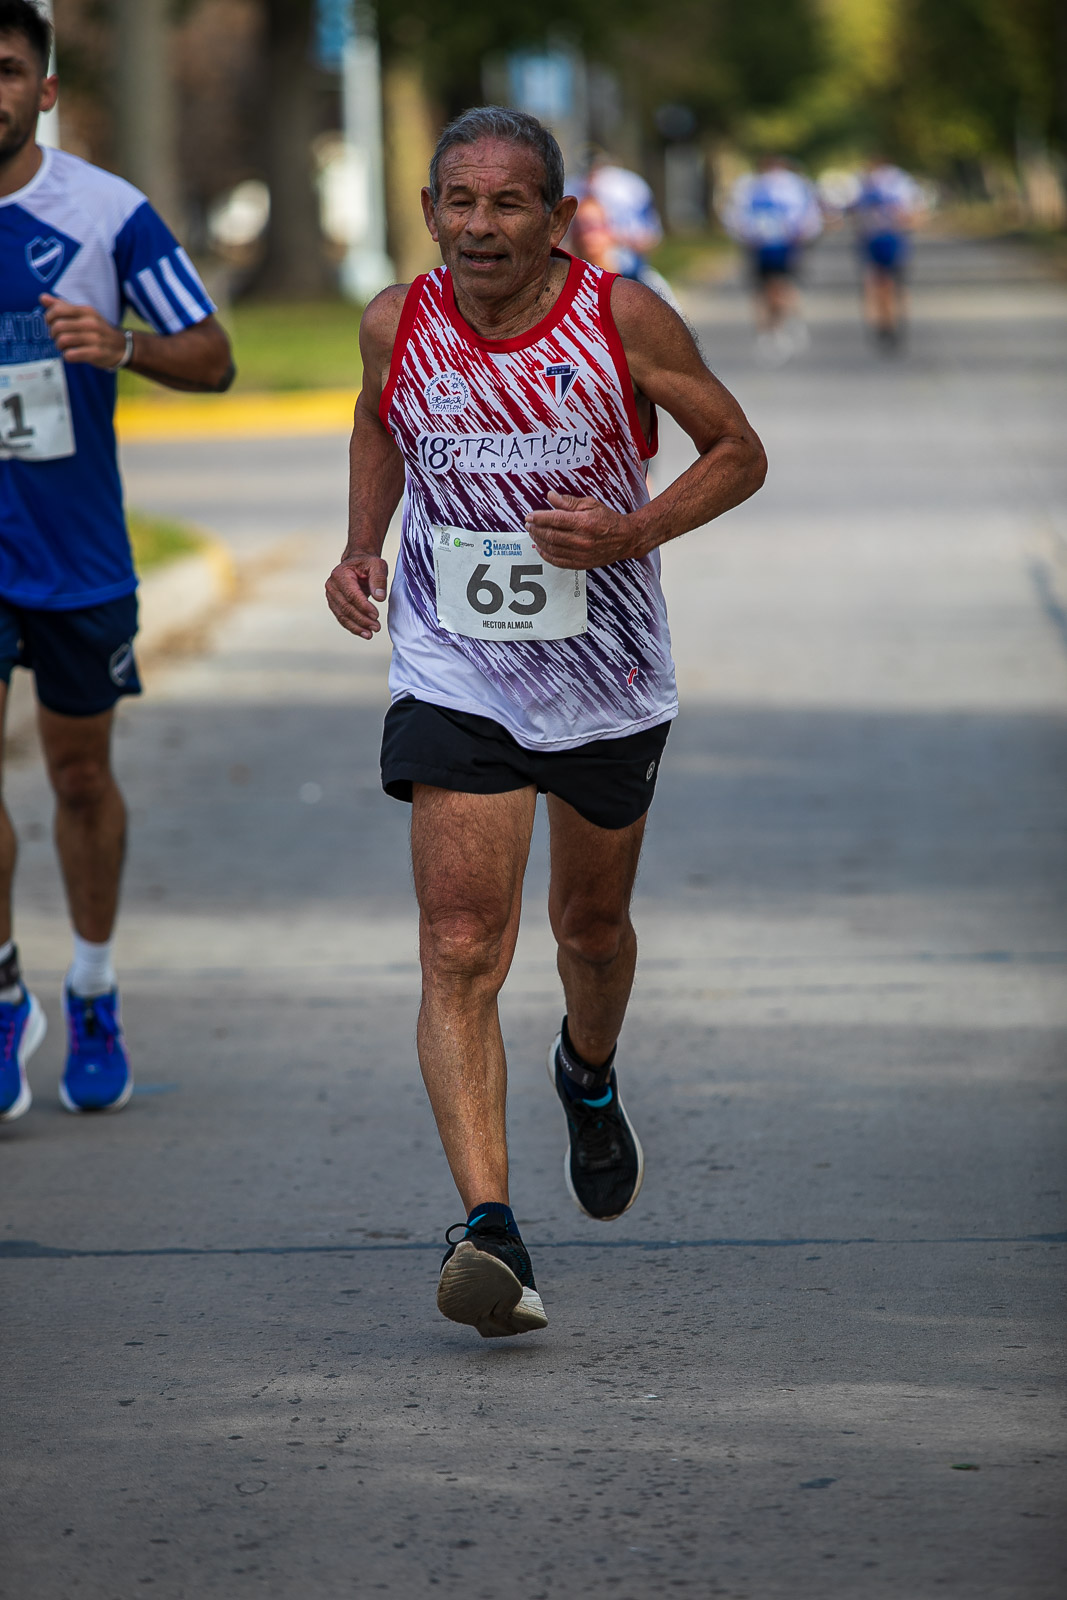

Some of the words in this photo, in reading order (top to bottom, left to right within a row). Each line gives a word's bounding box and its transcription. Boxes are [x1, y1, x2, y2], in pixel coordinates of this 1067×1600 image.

[0, 393, 35, 440] 1
[459, 431, 589, 464] TRIATLON
[482, 539, 493, 558] 3
[493, 542, 522, 551] MARATÓN
[466, 563, 547, 616] 65
[482, 620, 506, 630] HECTOR
[507, 620, 534, 630] ALMADA
